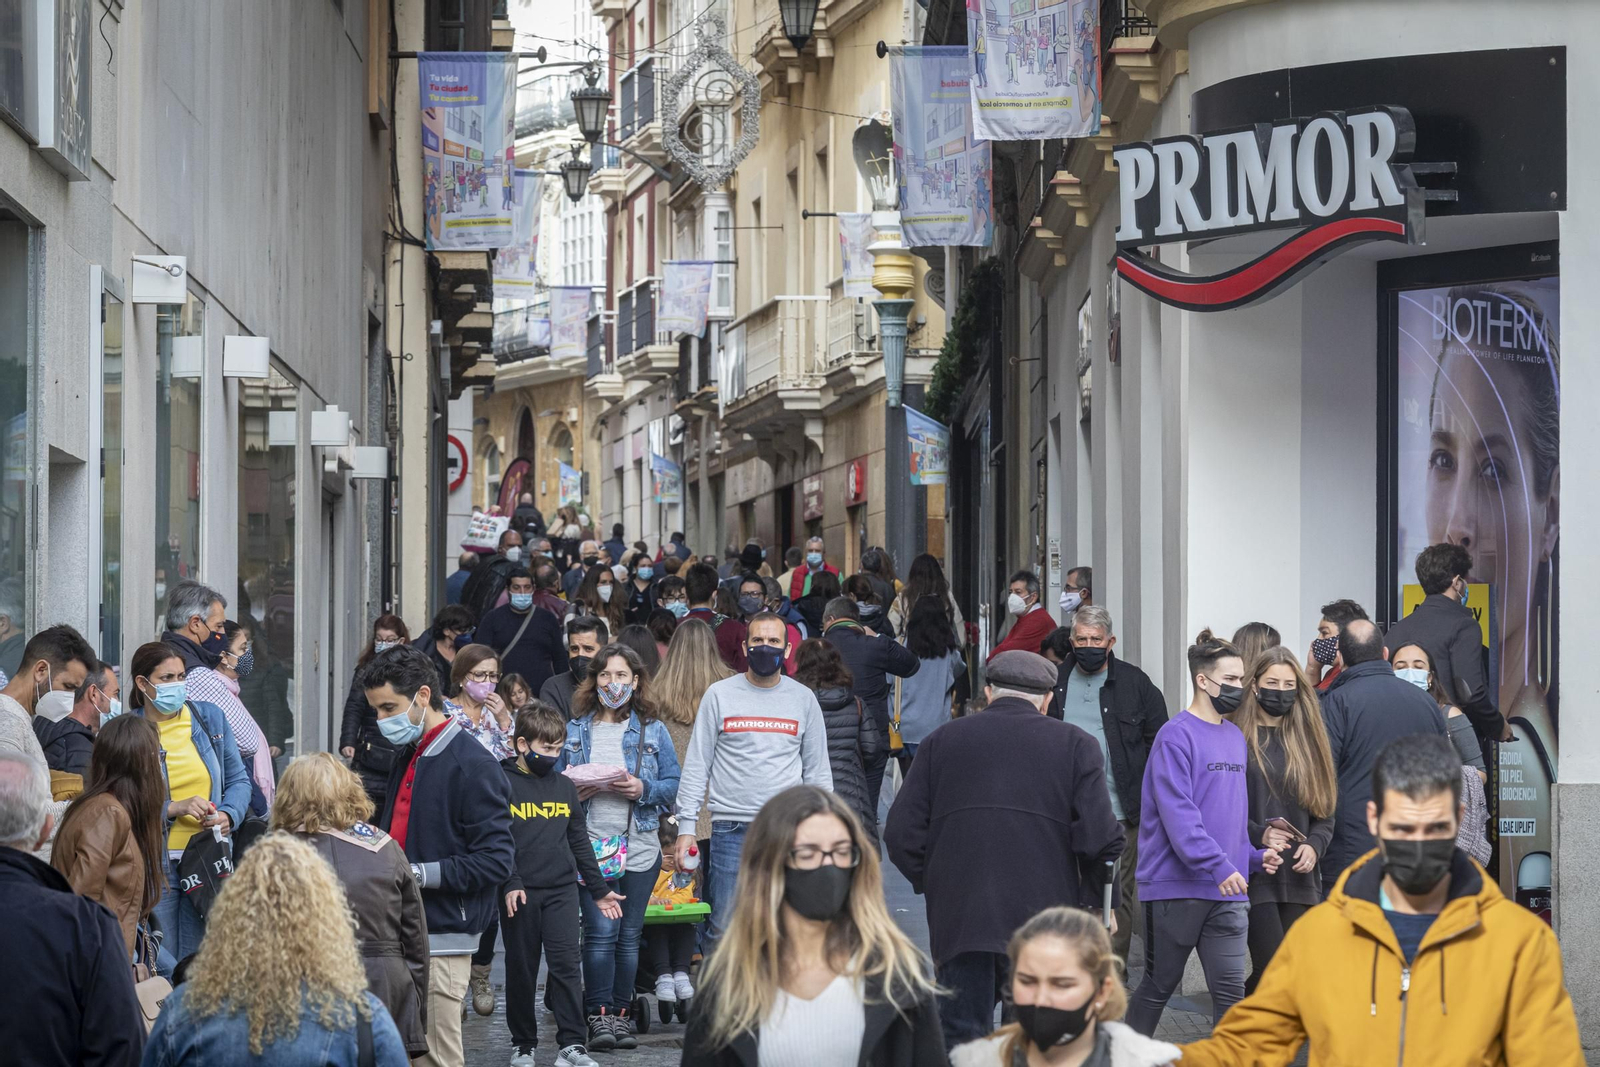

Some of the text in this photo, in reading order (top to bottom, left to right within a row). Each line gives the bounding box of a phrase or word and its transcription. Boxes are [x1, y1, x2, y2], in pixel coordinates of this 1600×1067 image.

[430, 74, 440, 82] Tu
[429, 83, 439, 91] Tu
[1114, 112, 1404, 241] PRIMOR
[1433, 295, 1549, 352] BIOTHERM
[1472, 350, 1491, 358] POWER
[1494, 351, 1501, 360] OF
[1503, 353, 1514, 361] LIFE
[1517, 354, 1546, 364] PLANKTON
[1501, 769, 1523, 783] TU PIEL
[1502, 787, 1537, 801] BIOCIENCIA
[510, 802, 570, 820] NINJA
[1499, 821, 1534, 833] LGAE UPLIFT
